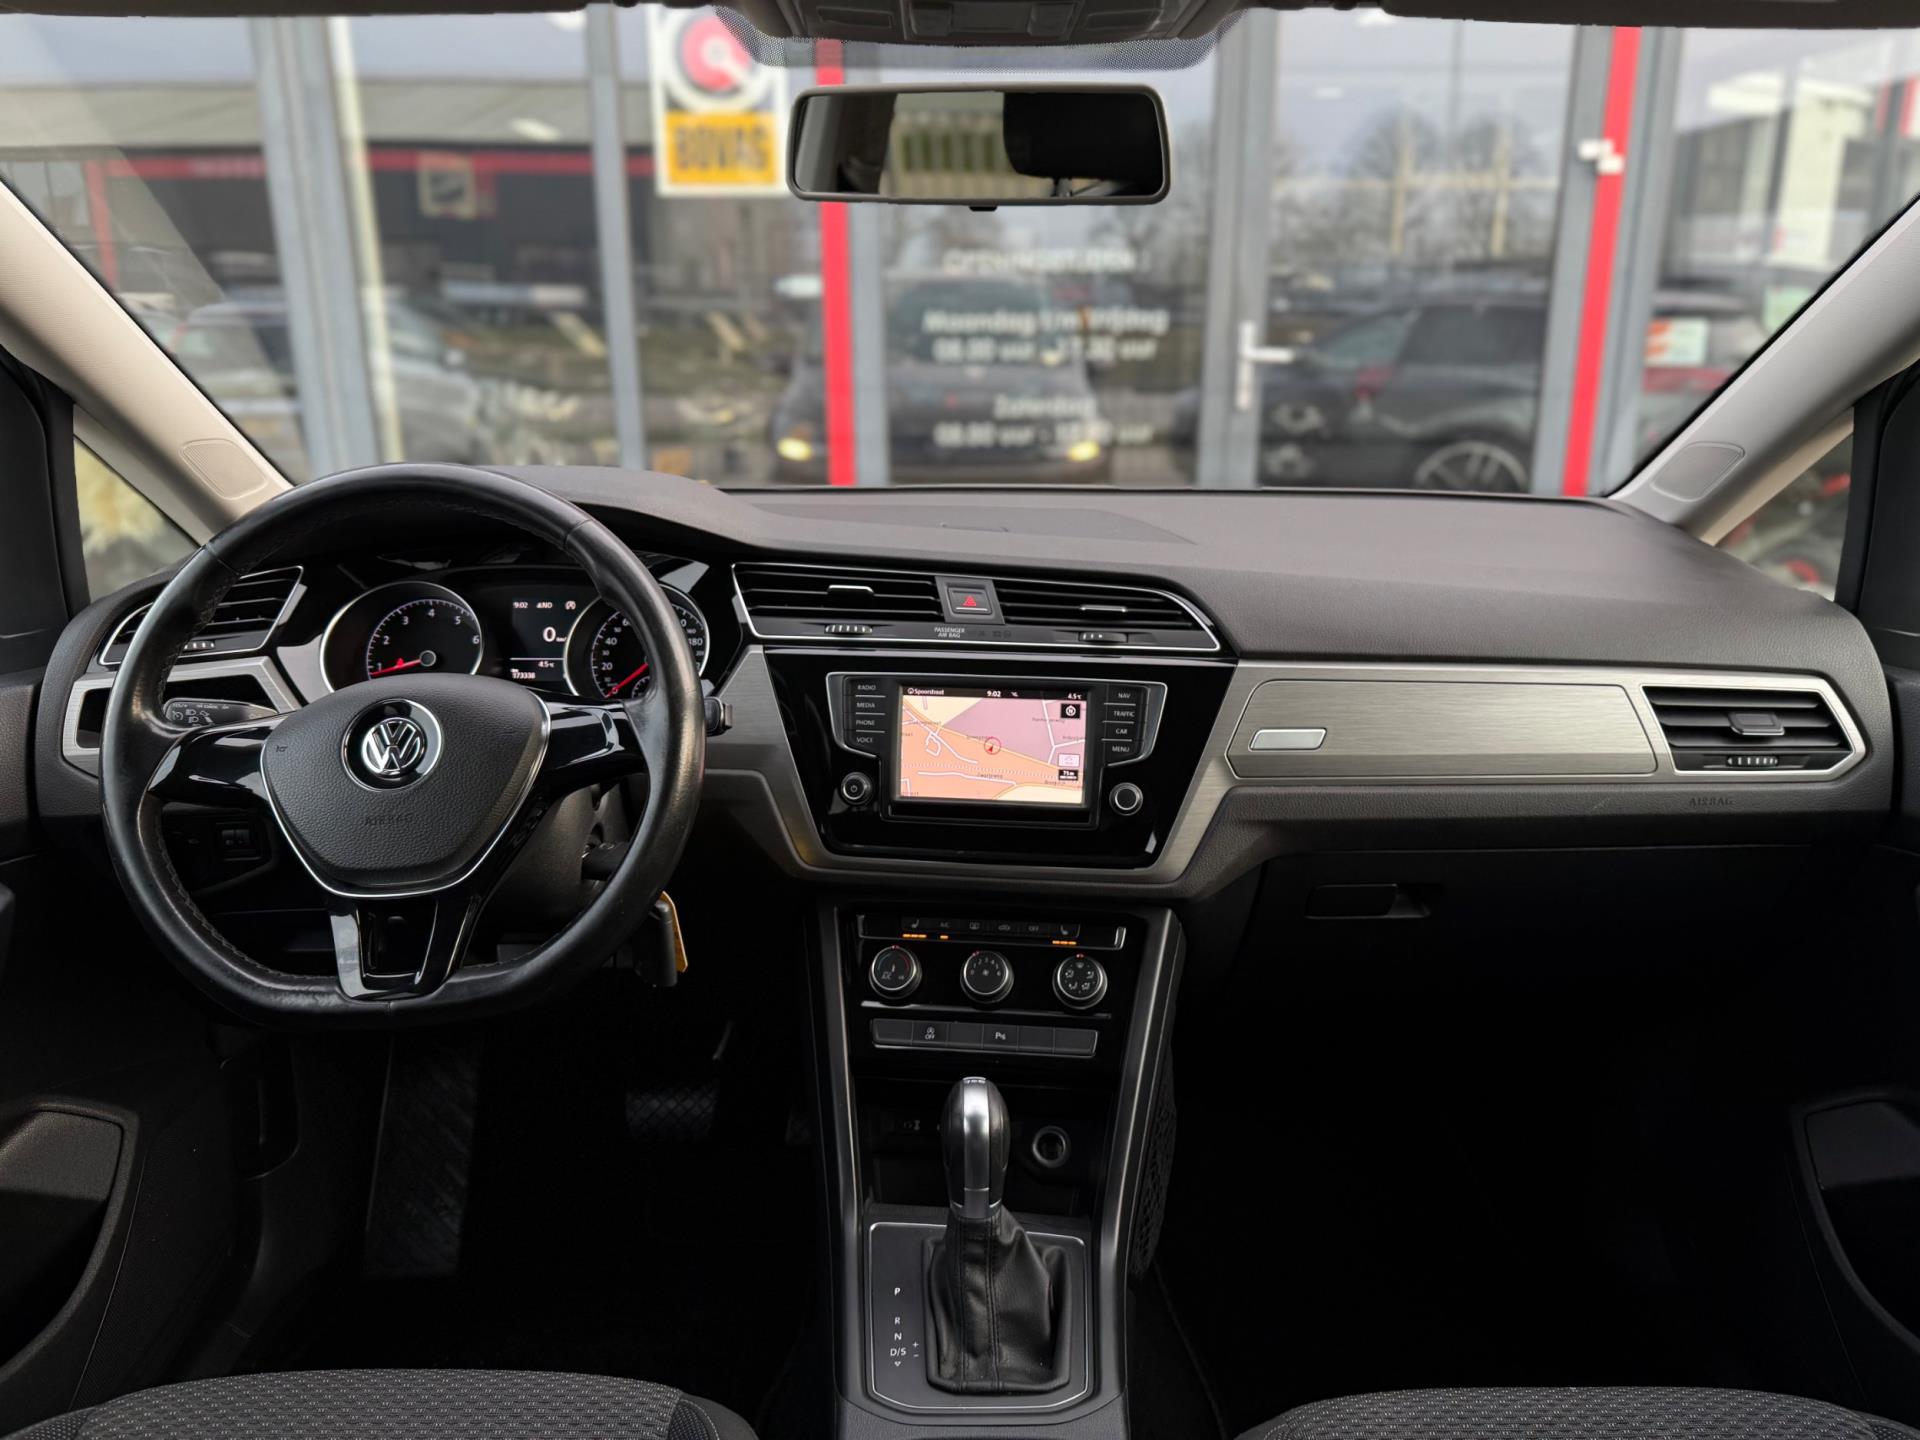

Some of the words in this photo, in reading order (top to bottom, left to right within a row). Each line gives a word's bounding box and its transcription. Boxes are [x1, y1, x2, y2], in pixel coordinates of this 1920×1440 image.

[428, 608, 435, 617] 4
[402, 616, 409, 625] 3
[454, 616, 461, 625] 5
[543, 626, 557, 643] 0
[383, 635, 390, 645] 2
[472, 635, 480, 645] 6
[605, 637, 618, 646] 40
[601, 662, 613, 671] 20
[1117, 692, 1131, 700] NAV
[1113, 710, 1135, 718] TRAFFIC
[894, 1287, 901, 1297] P
[894, 1316, 901, 1326] R
[894, 1332, 902, 1341] N
[890, 1347, 907, 1357] D/S
